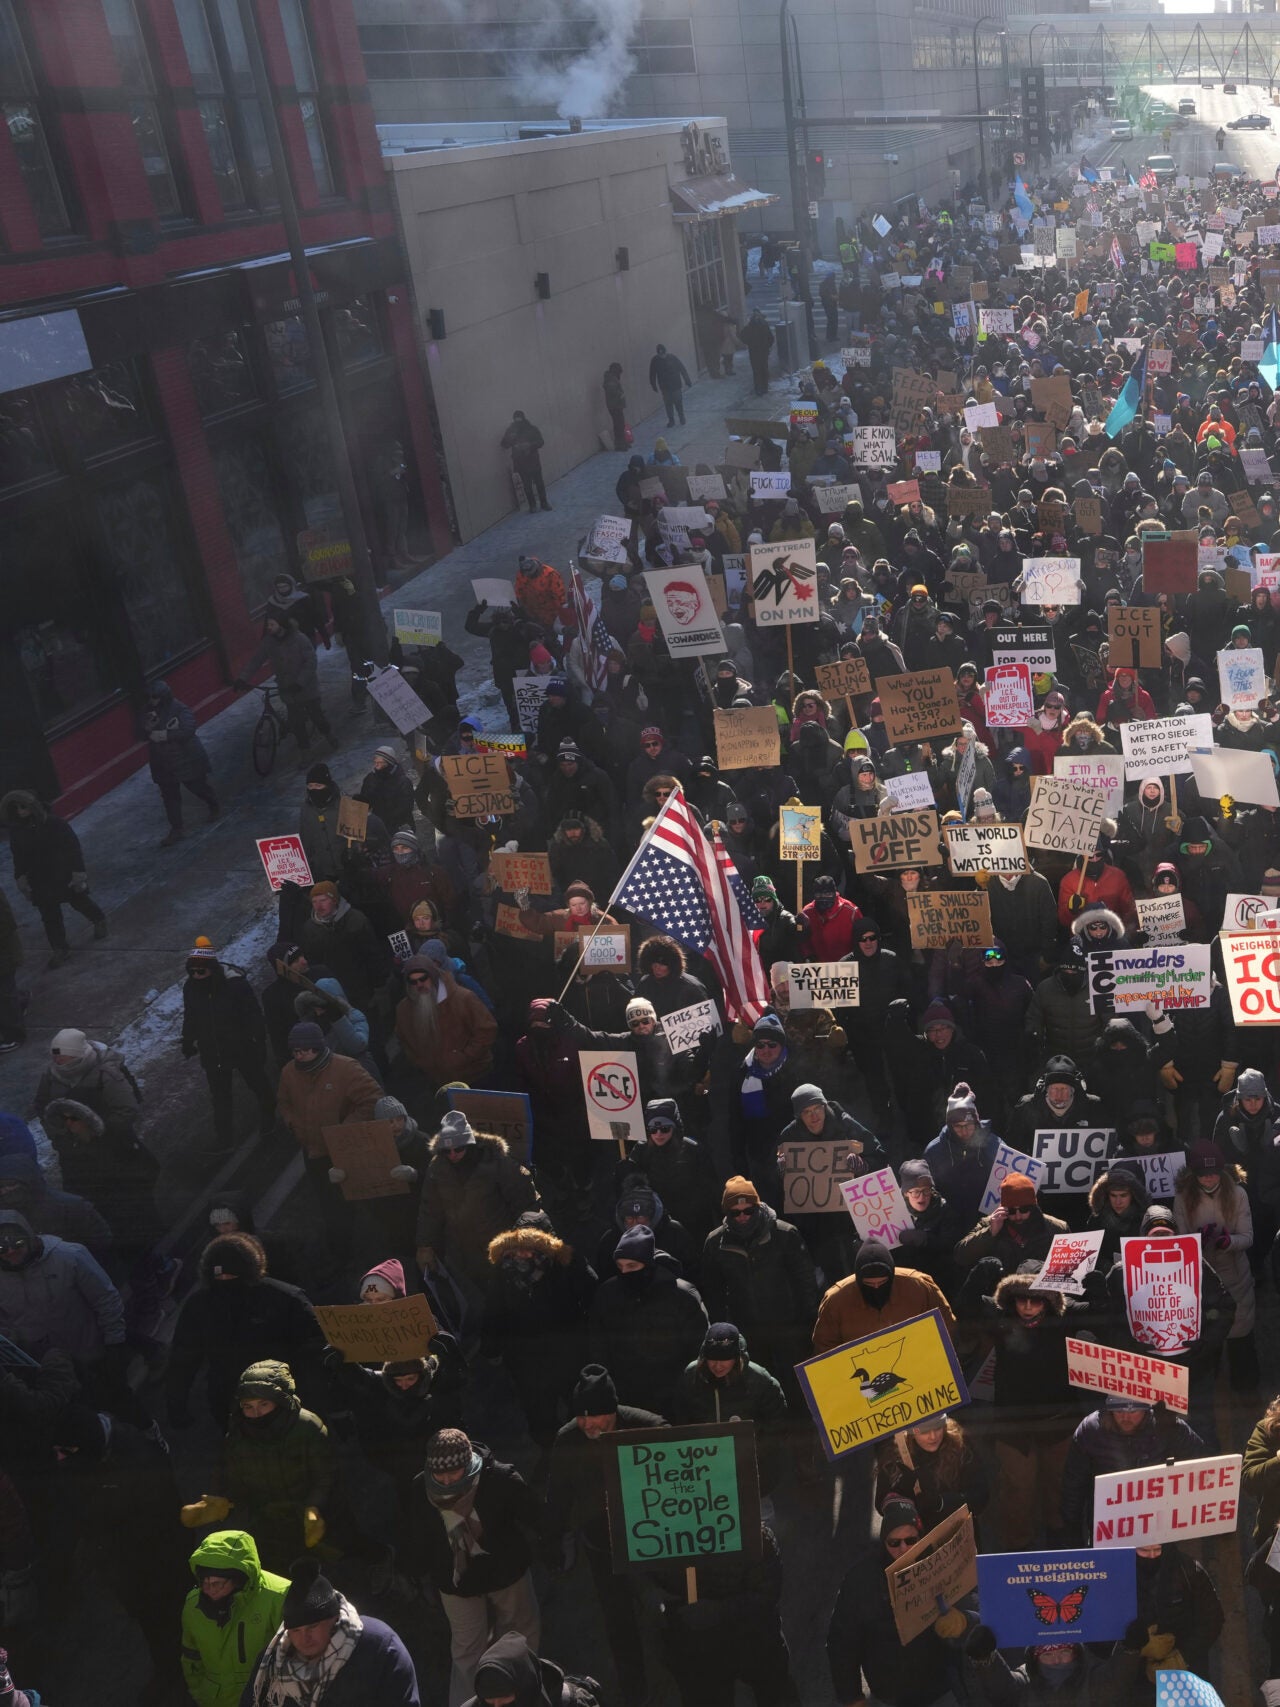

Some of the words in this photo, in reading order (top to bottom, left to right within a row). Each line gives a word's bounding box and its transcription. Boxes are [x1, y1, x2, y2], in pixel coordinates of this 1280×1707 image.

[986, 324, 1012, 333] FUCK
[855, 429, 868, 440] WE
[872, 427, 894, 440] KNOW
[854, 451, 868, 462] WE
[871, 450, 893, 461] SAW
[1117, 610, 1151, 621] ICE
[668, 631, 720, 645] COWARDICE
[1114, 625, 1152, 637] OUT
[1128, 718, 1186, 732] OPERATION
[1131, 733, 1165, 743] METRO
[1168, 730, 1197, 740] SIEGE:
[496, 741, 526, 752] OUT
[1132, 747, 1146, 756] 0%
[1151, 743, 1188, 754] SAFETY
[452, 755, 499, 776] ICE
[1125, 758, 1148, 768] 100%
[456, 792, 513, 815] GESTAPO
[860, 814, 932, 844] HANDS
[947, 830, 971, 841] THE
[975, 828, 1018, 841] WORLD
[870, 839, 922, 864] OFF
[978, 844, 992, 854] IS
[953, 856, 1026, 871] WATCHING
[271, 867, 305, 876] MINNEAPOLIS
[910, 896, 932, 908] THE
[940, 892, 983, 907] SMALLEST
[1139, 900, 1180, 914] INJUSTICE
[920, 908, 944, 920] MEN
[947, 908, 969, 919] WHO
[1142, 911, 1180, 923] ANYWHERE
[917, 922, 944, 936] EVER
[947, 920, 979, 933] LIVED
[594, 937, 613, 945] FOR
[966, 936, 981, 946] ICE
[590, 948, 616, 957] GOOD
[791, 968, 820, 978] SAY
[811, 989, 856, 1000] NAME
[599, 1074, 632, 1099] ICE
[320, 1304, 375, 1329] Please
[380, 1303, 420, 1324] Stop
[326, 1324, 436, 1347] MURDERING
[373, 1343, 397, 1358] US
[1067, 1340, 1183, 1378] SUPPORT
[1101, 1362, 1151, 1385] OUR
[1069, 1368, 1188, 1410] NEIGHBORS
[863, 1406, 914, 1440] TREAD
[918, 1392, 936, 1415] ON
[937, 1383, 958, 1409] ME
[632, 1445, 664, 1466] Do
[677, 1443, 718, 1469] you
[645, 1462, 708, 1485] Hear
[672, 1480, 694, 1494] the
[1106, 1466, 1235, 1506] JUSTICE
[640, 1486, 729, 1521] People
[1096, 1514, 1154, 1542] NOT
[1171, 1500, 1236, 1528] LIES
[632, 1517, 735, 1559] Sing?
[1017, 1563, 1040, 1573] We
[1043, 1559, 1095, 1573] protect
[1007, 1576, 1032, 1585] our
[1034, 1570, 1108, 1583] neighbors
